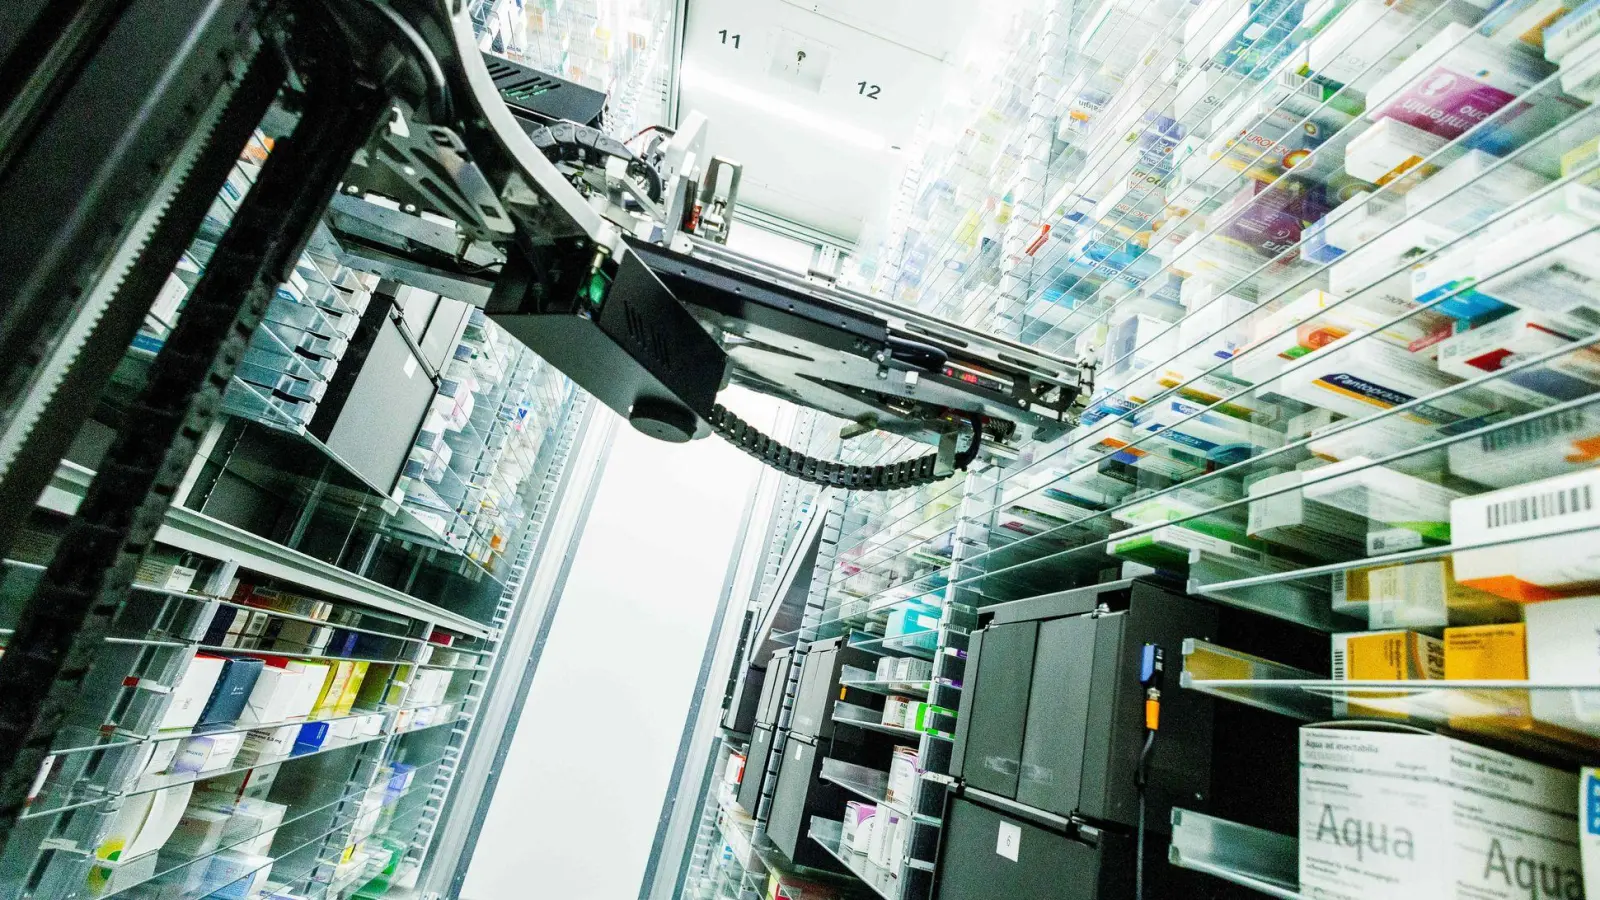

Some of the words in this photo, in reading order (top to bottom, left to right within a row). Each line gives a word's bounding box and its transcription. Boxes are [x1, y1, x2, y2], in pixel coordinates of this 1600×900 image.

[718, 29, 741, 49] 11
[856, 80, 882, 100] 12
[1305, 740, 1323, 749] Aqua
[1325, 741, 1335, 749] ad
[1316, 803, 1415, 862] Aqua
[1484, 838, 1584, 900] Aqua
